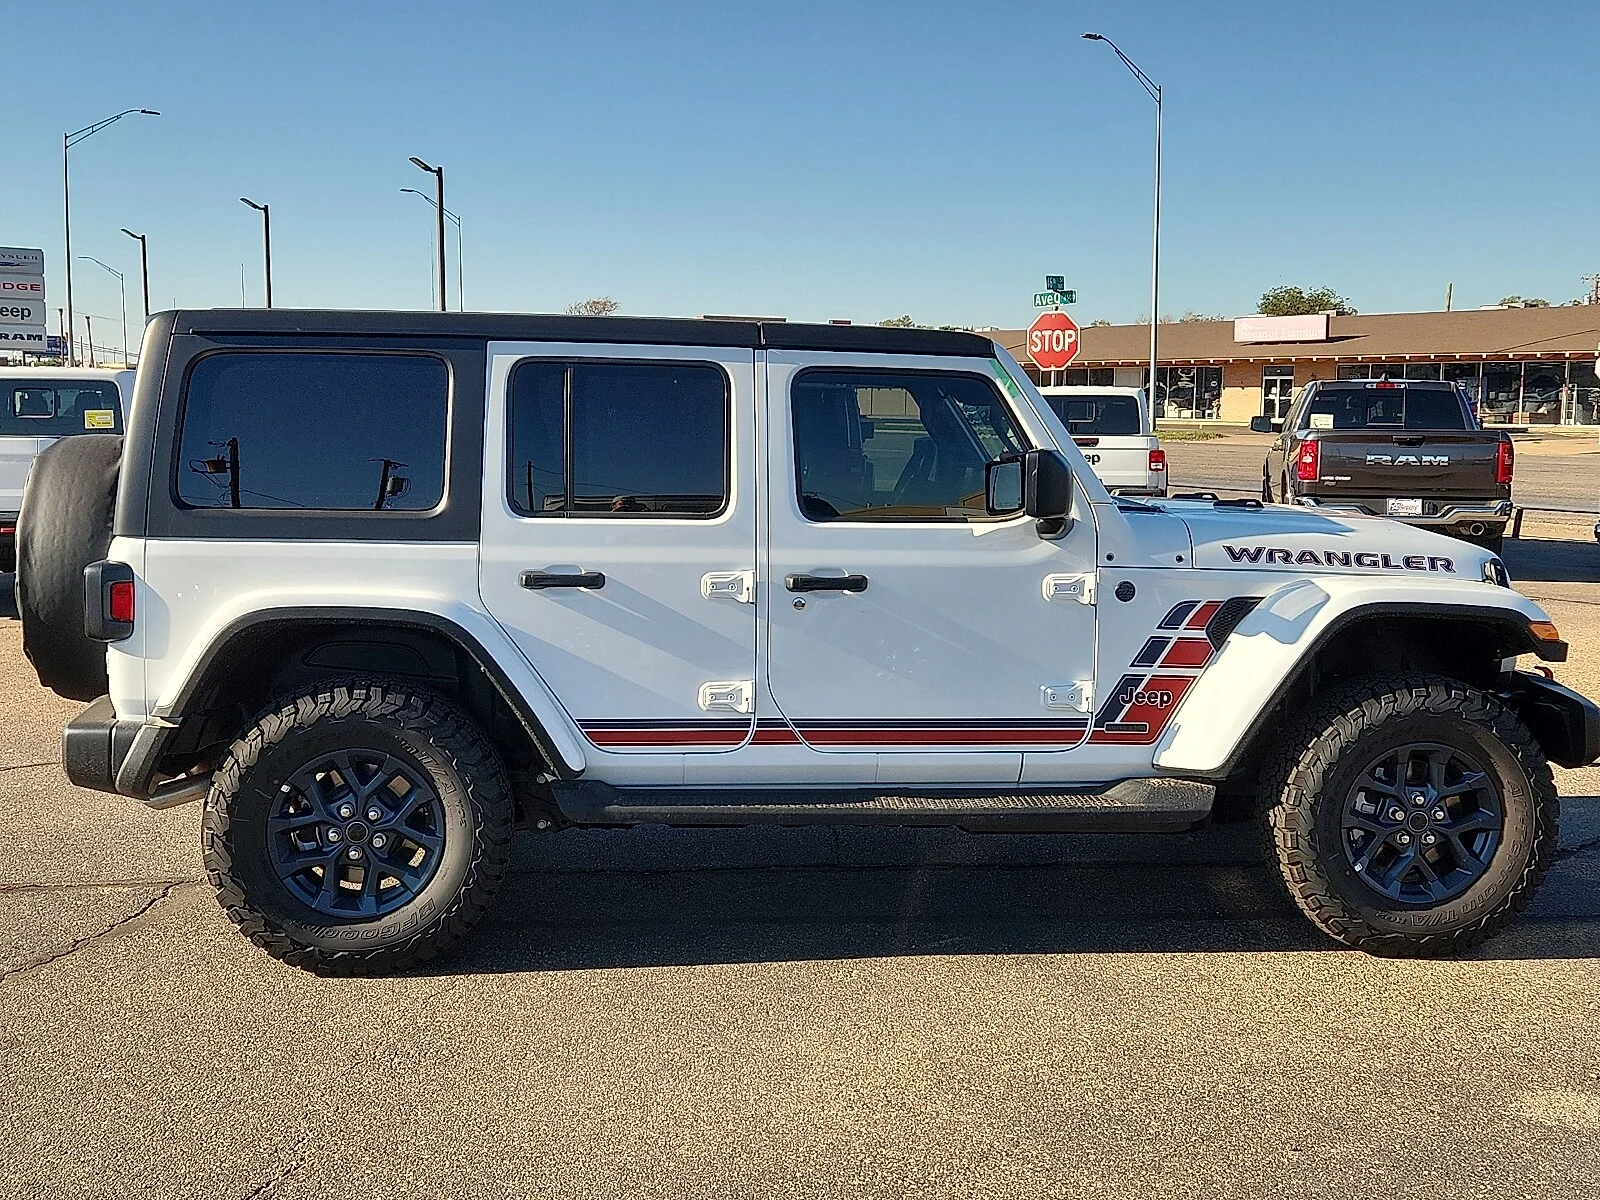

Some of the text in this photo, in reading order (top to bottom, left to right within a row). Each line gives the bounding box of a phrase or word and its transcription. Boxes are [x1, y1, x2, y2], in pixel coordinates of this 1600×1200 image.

[0, 282, 42, 292] DGE
[1035, 293, 1053, 306] Ave
[0, 332, 43, 342] RAM
[1030, 329, 1076, 353] STOP
[1366, 454, 1449, 466] RAM
[1222, 544, 1457, 573] WRANGLER
[1119, 686, 1173, 709] Jeep
